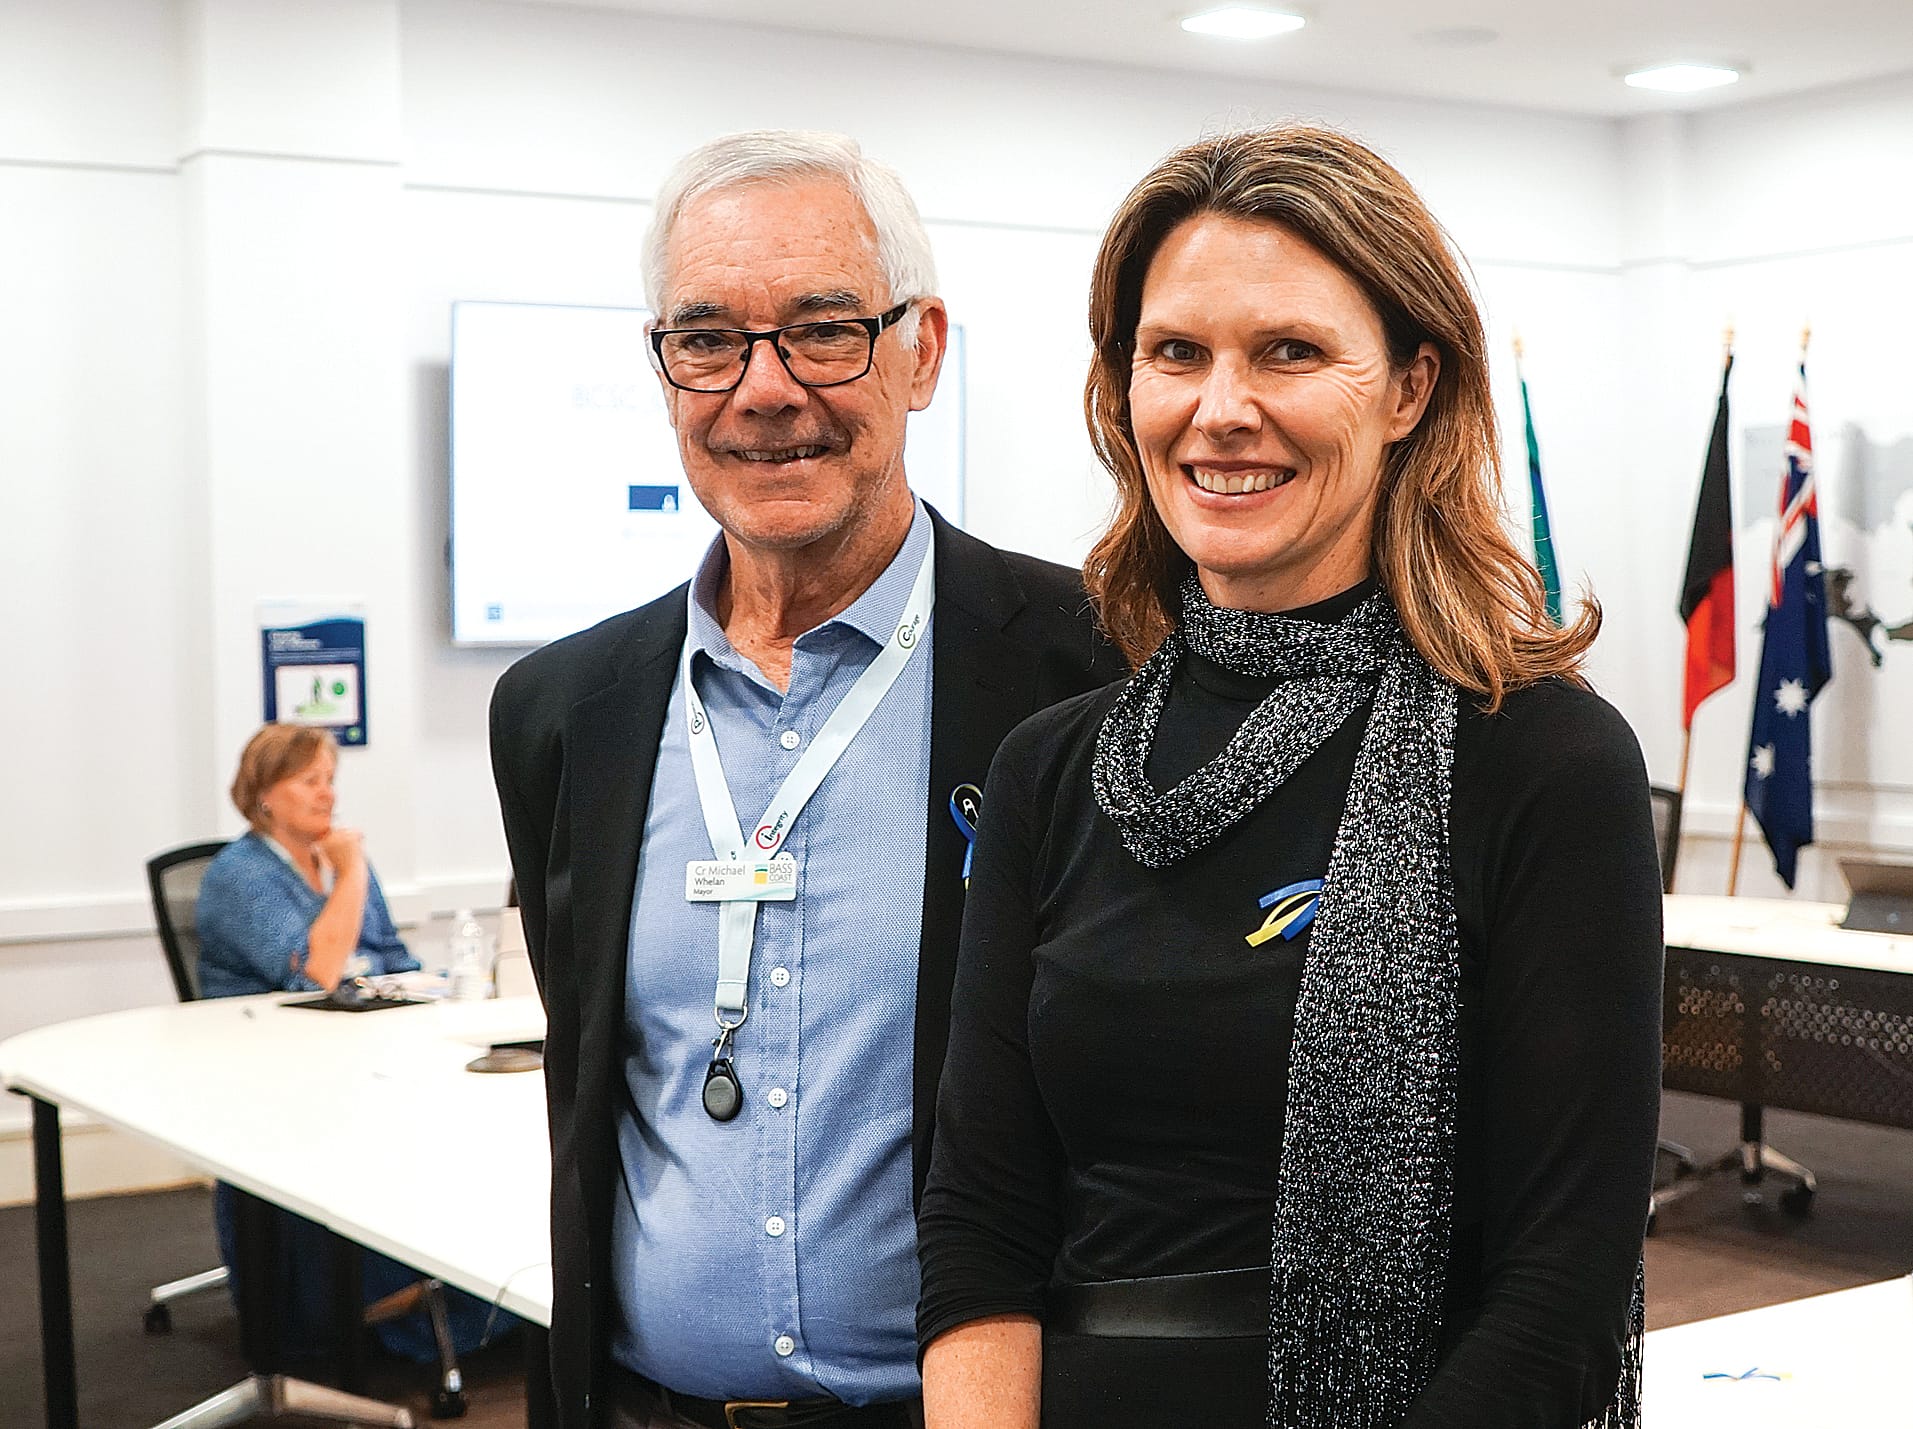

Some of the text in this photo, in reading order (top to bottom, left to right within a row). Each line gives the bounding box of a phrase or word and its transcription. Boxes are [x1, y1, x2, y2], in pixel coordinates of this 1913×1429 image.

[695, 865, 746, 876] Cr Michael
[769, 863, 793, 873] BASS
[694, 877, 725, 886] Whelan
